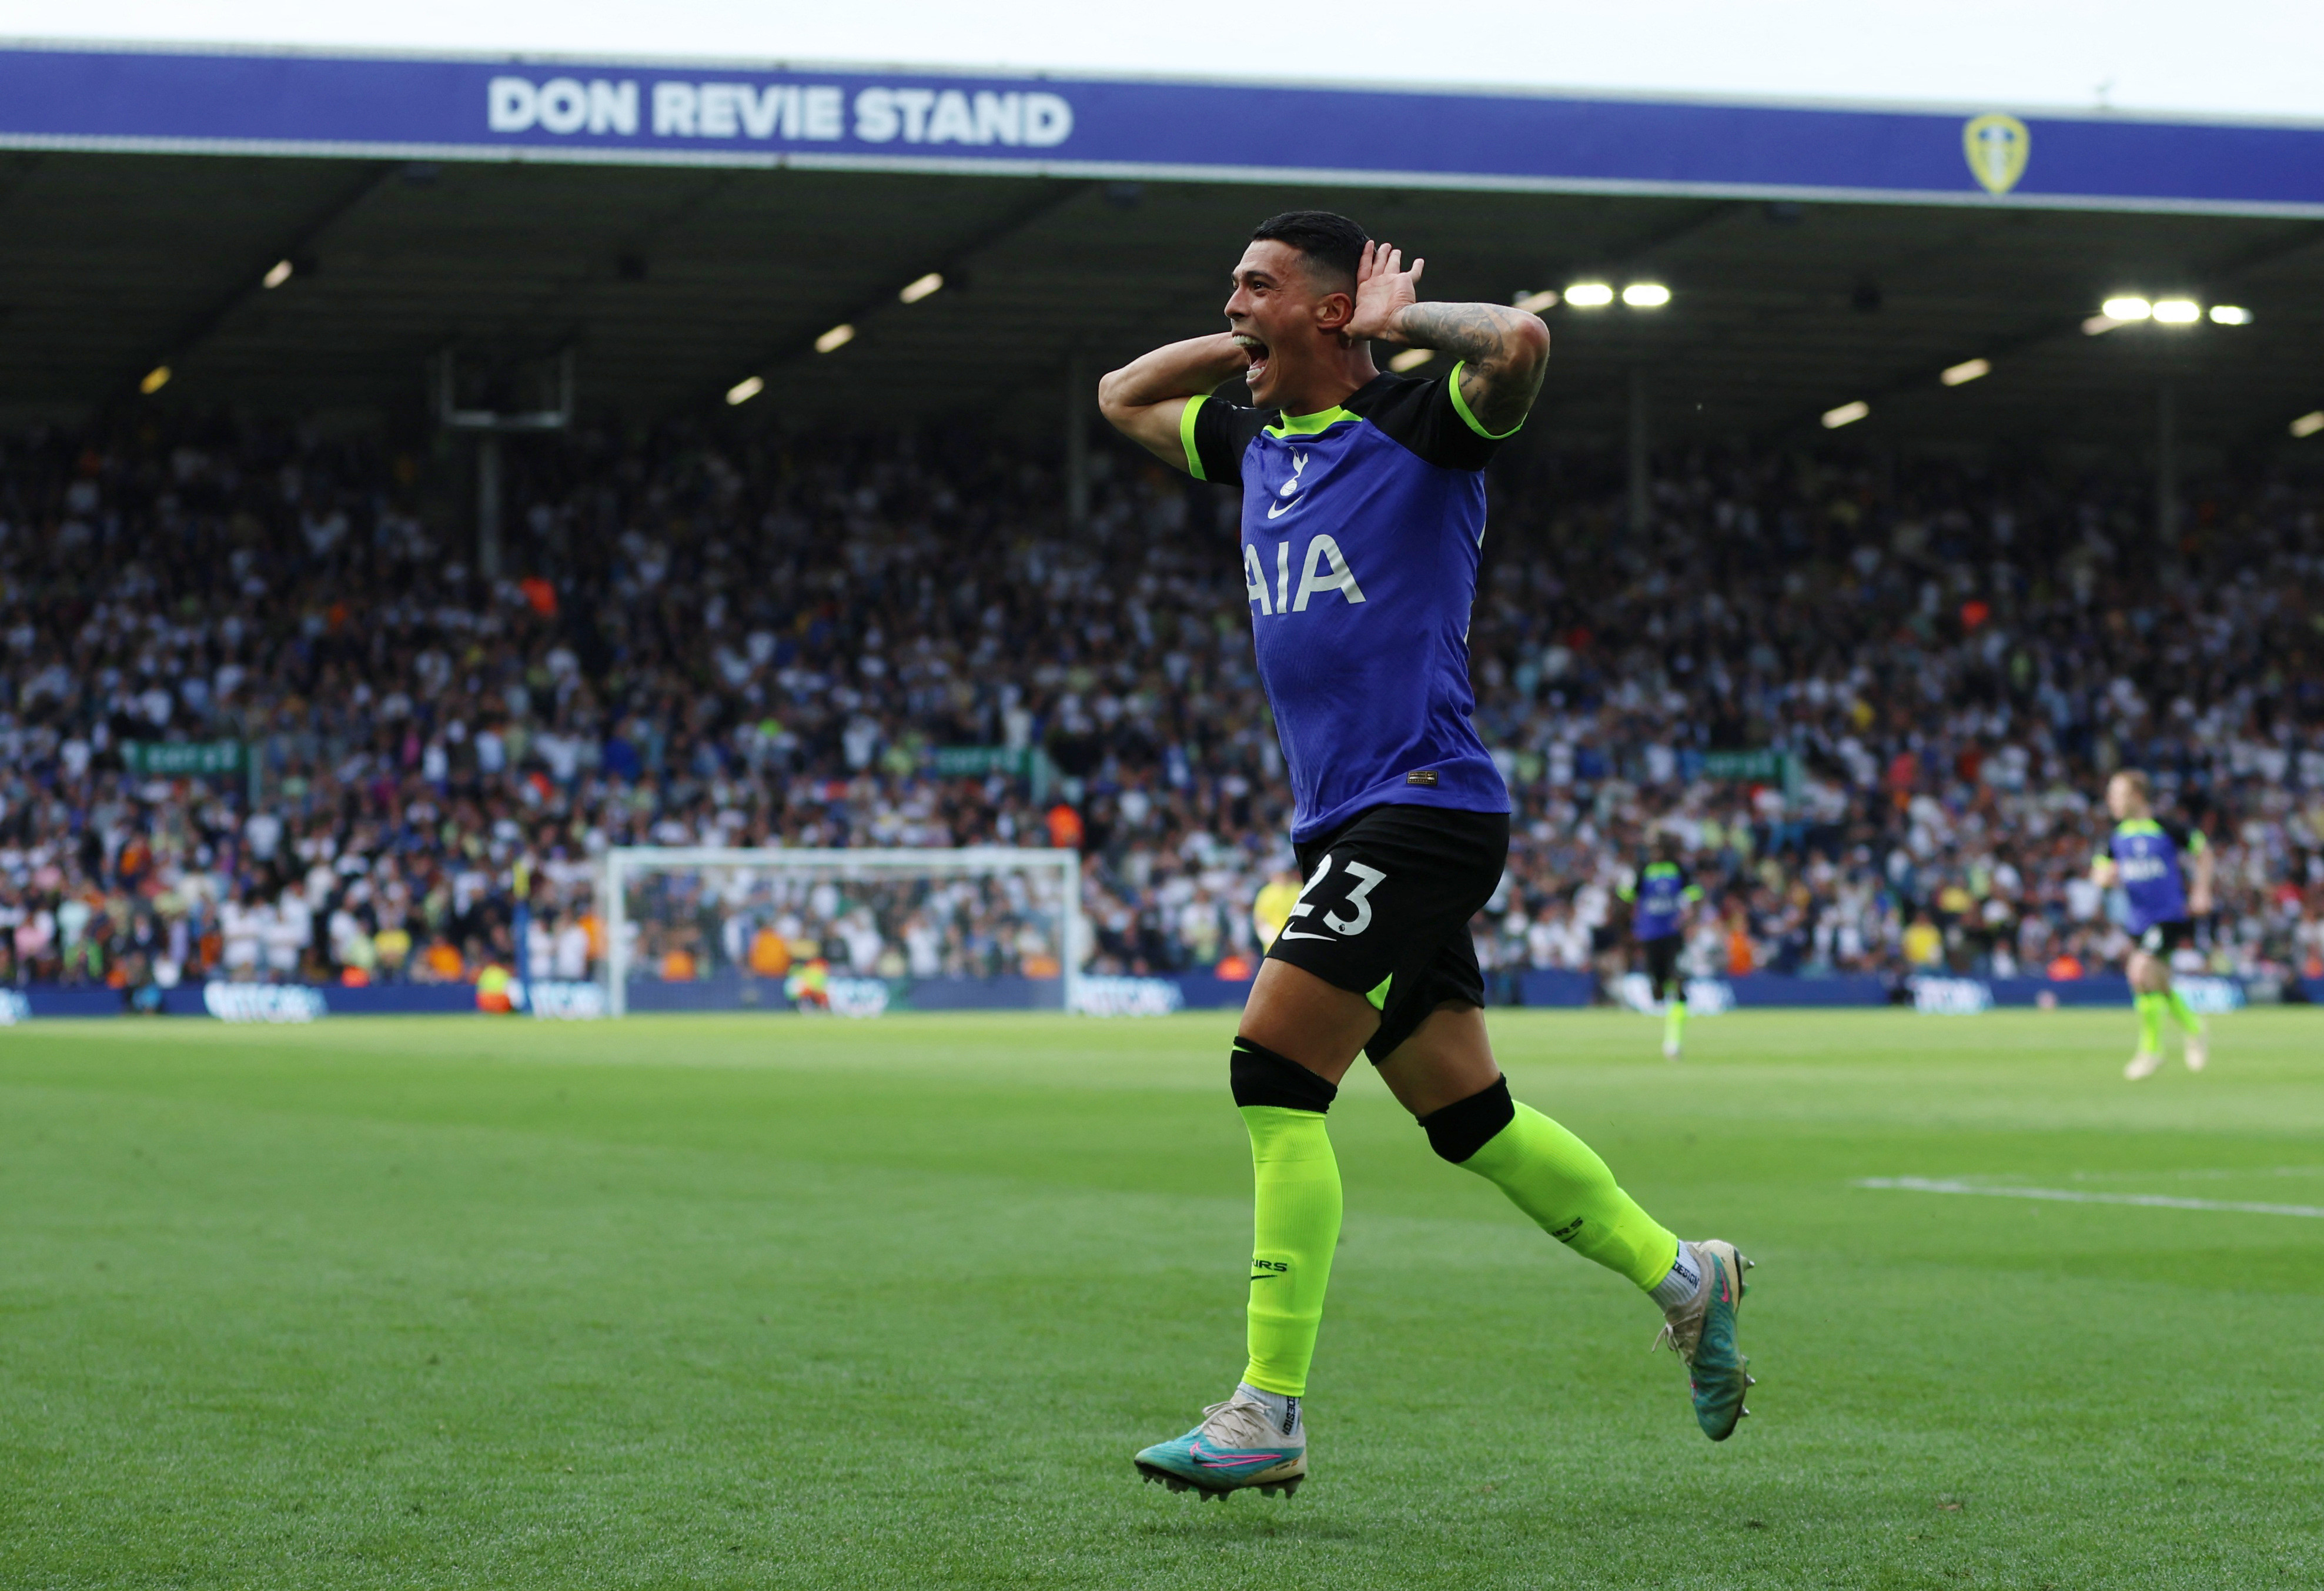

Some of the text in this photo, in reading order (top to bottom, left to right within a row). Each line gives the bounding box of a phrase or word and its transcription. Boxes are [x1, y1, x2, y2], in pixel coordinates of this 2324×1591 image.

[487, 76, 1074, 148] DON REVIE STAND
[1245, 533, 1367, 616] AIA
[1289, 854, 1387, 935] 23
